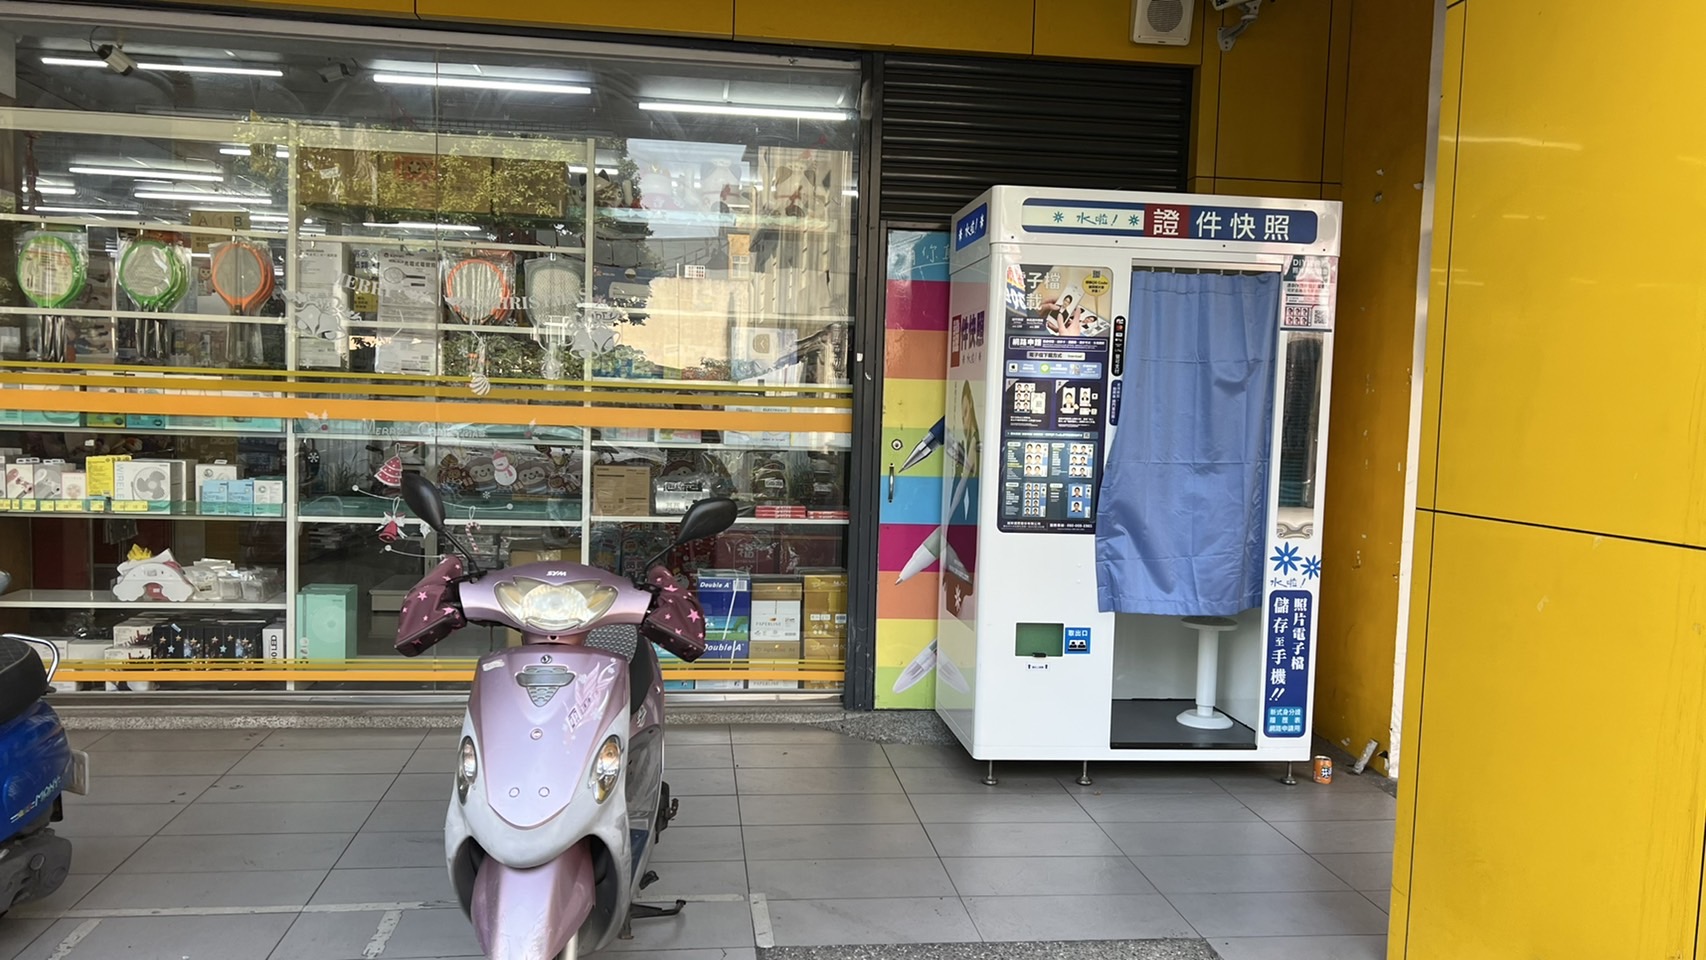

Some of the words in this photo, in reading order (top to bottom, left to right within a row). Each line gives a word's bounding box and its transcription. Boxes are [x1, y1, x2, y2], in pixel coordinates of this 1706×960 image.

[234, 216, 243, 227] B
[1076, 211, 1119, 226] 水啦!
[1152, 208, 1291, 241] 證件快照
[1024, 271, 1061, 290] 子檔
[116, 463, 125, 499] WIRELE
[735, 643, 742, 651] A
[1269, 596, 1290, 701] 儲存至手機!!
[1291, 597, 1308, 670] 照片電子檔
